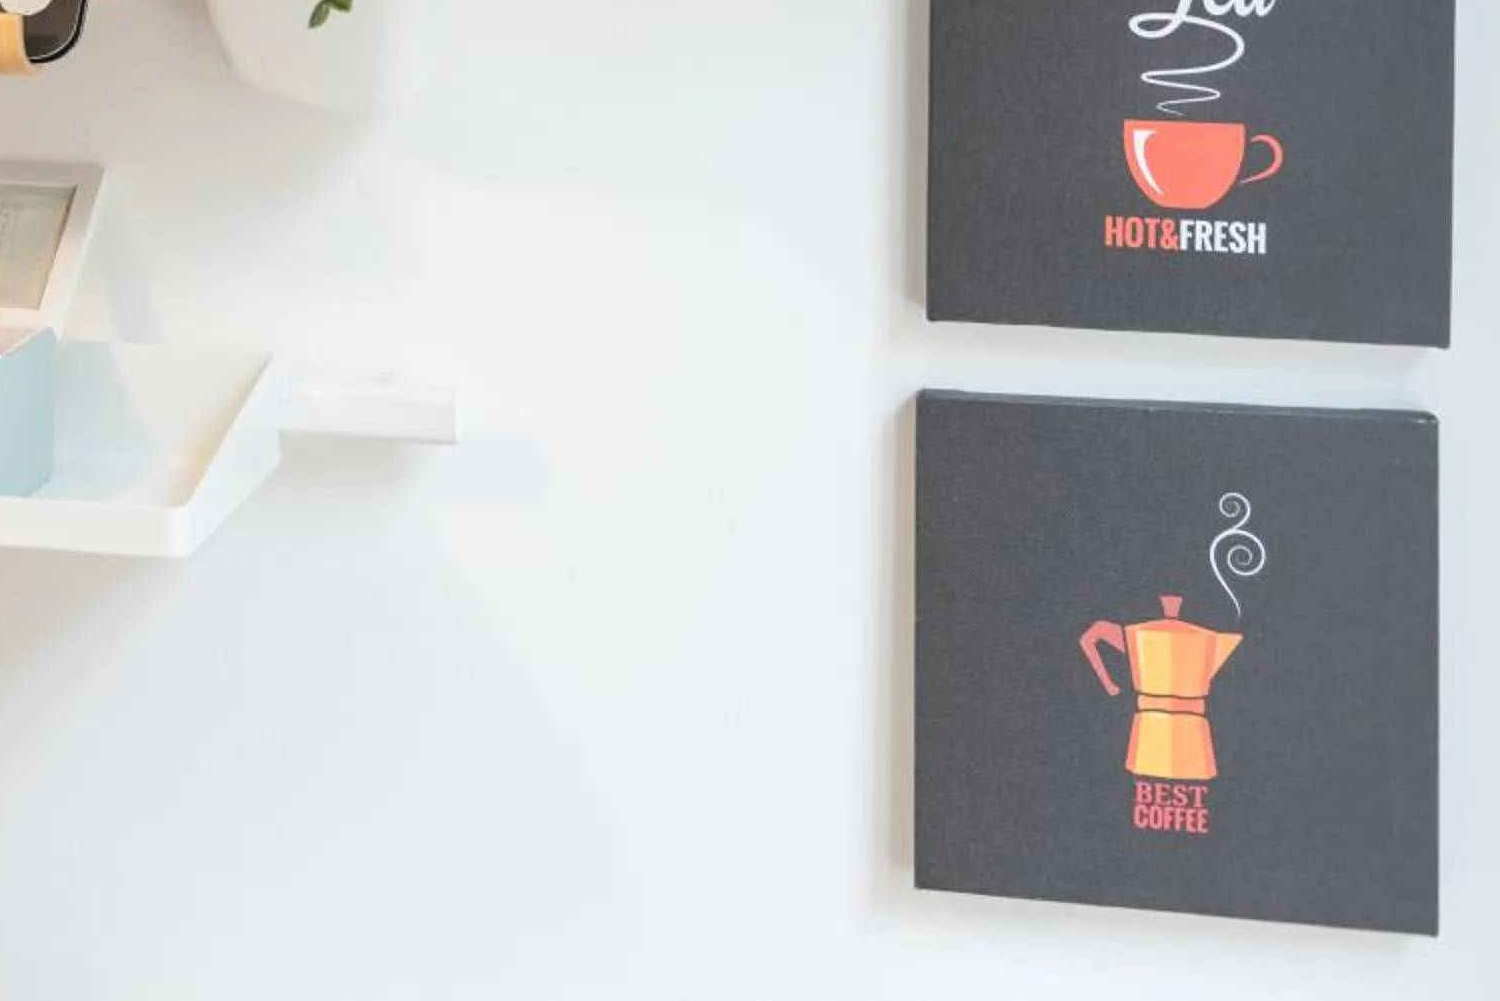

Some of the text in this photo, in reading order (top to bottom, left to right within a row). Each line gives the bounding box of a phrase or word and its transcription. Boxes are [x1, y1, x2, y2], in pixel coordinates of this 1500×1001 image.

[1105, 215, 1267, 255] HOT&FRESH
[1134, 781, 1208, 808] BEST
[1133, 805, 1208, 833] COFFEE
